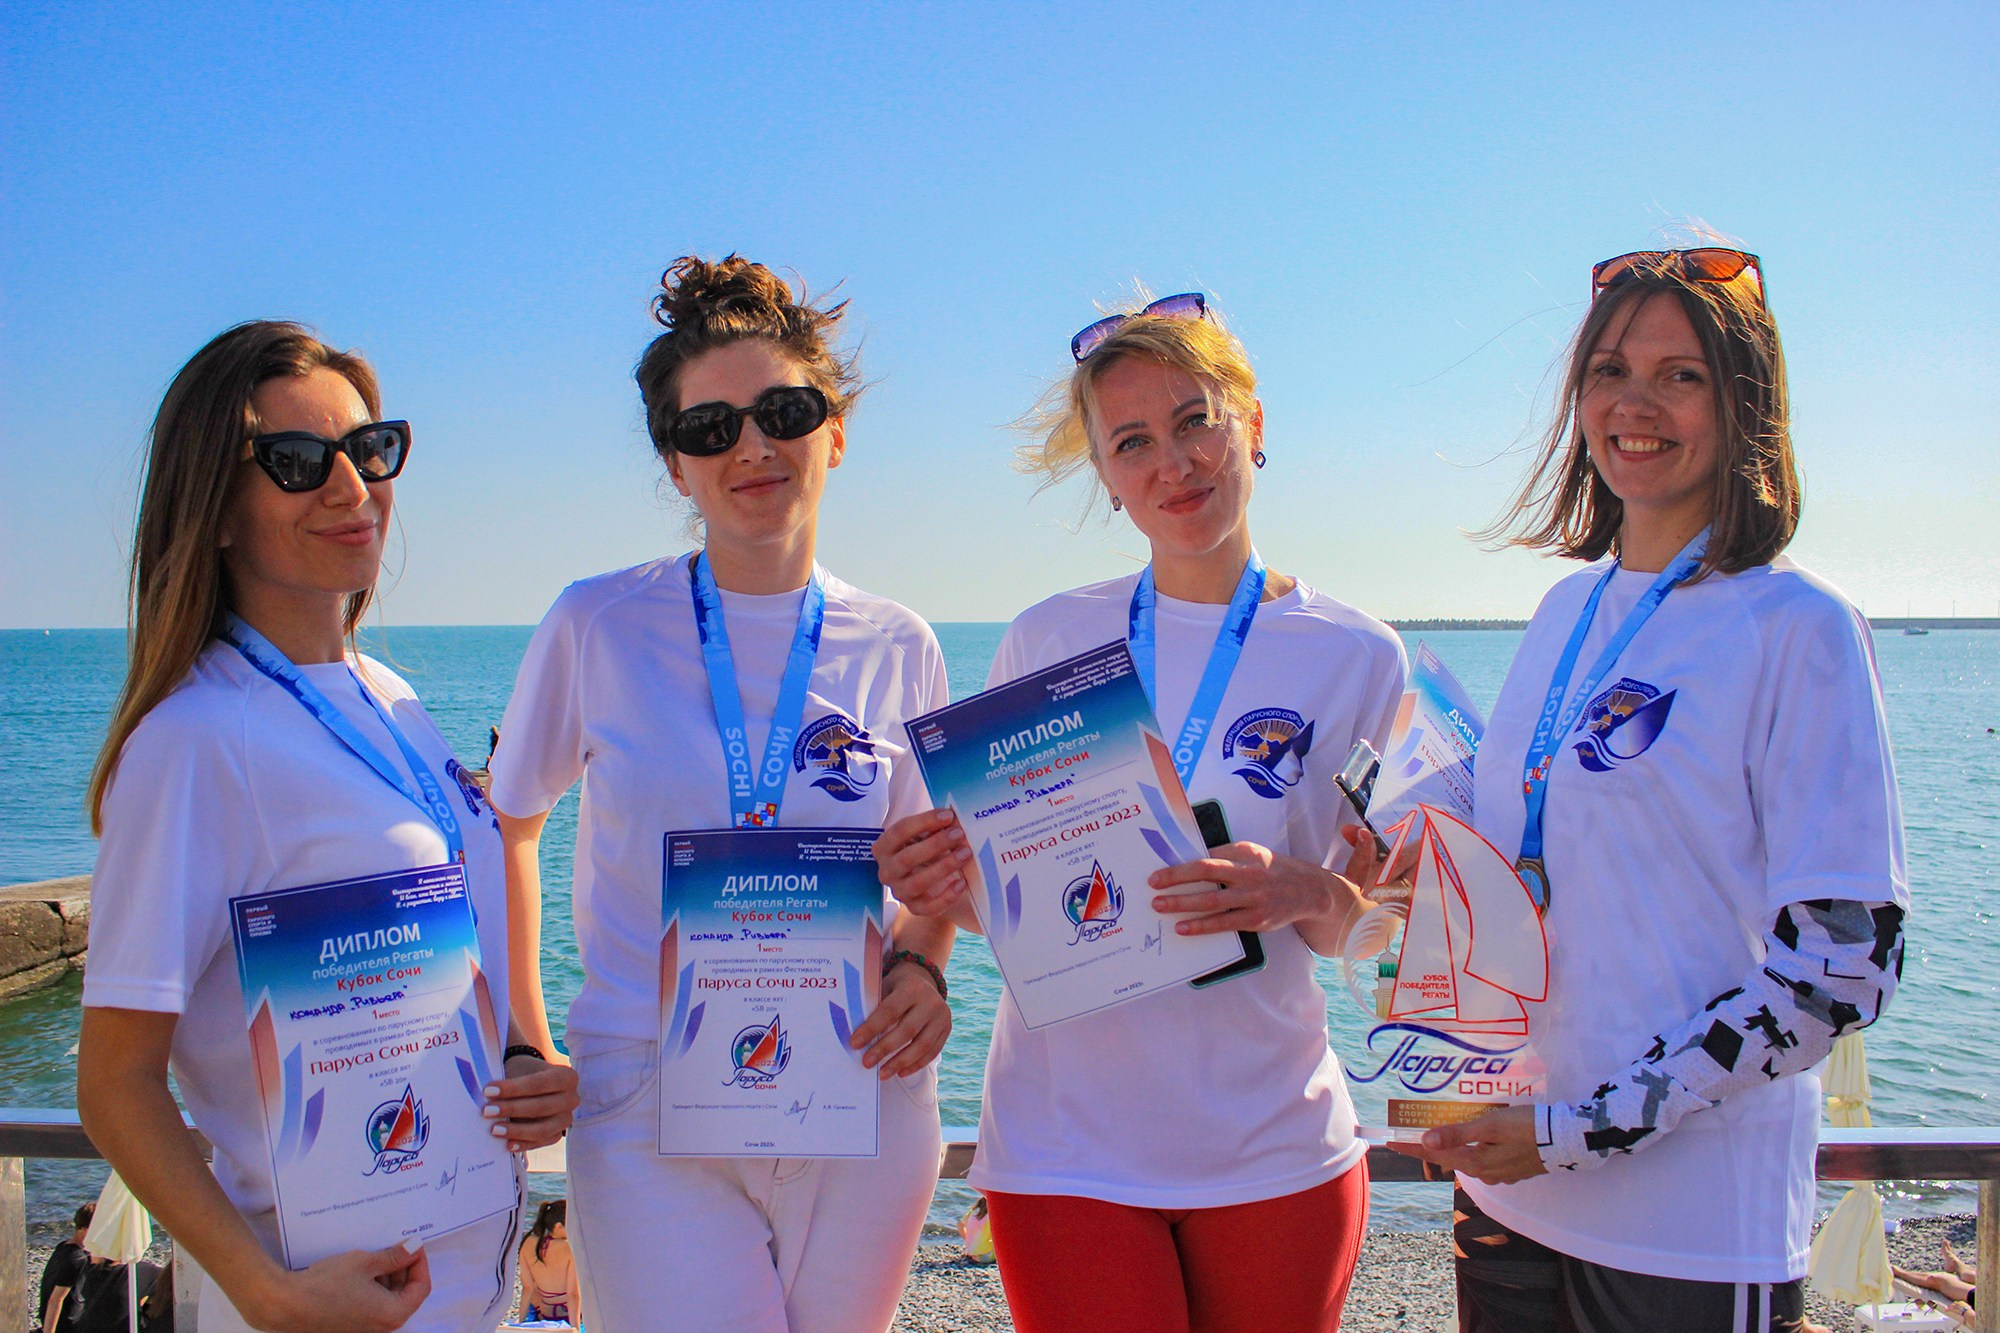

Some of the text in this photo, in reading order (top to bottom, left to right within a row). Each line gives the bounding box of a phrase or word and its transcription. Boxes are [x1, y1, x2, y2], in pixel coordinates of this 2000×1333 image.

[1243, 709, 1282, 724] ПАРУСНОГО
[1531, 685, 1563, 753] SOCHI
[1554, 678, 1595, 741] СОЧИ
[988, 710, 1084, 766] ДИПЛОМ
[725, 727, 751, 798] SOCHI
[763, 726, 793, 788] СОЧИ
[985, 731, 1100, 781] победителя Регаты
[1008, 751, 1090, 787] Кубок Сочи
[1247, 776, 1268, 787] СОЧИ
[418, 772, 457, 834] СОЧИ
[1047, 794, 1075, 808] 1 место
[1003, 814, 1055, 838] соревнованиях
[1055, 810, 1064, 819] по
[1065, 798, 1100, 817] парусному
[1011, 824, 1053, 845] проводимых
[1059, 814, 1083, 829] рамках
[1083, 800, 1120, 818] Фестиваля
[1001, 804, 1141, 864] Паруса Сочи 2023
[1060, 846, 1084, 859] классе
[721, 874, 818, 897] ДИПЛОМ
[713, 896, 828, 910] победителя Регаты
[1093, 904, 1115, 917] 2023
[731, 910, 811, 924] Кубок Сочи
[319, 922, 421, 965] ДИПЛОМ
[1066, 920, 1117, 946] Паруса
[757, 943, 762, 953] 1
[312, 948, 434, 980] победителя Регаты
[711, 967, 753, 975] проводимых
[758, 967, 783, 975] рамках
[783, 966, 821, 974] Фестиваля
[768, 958, 805, 966] парусному
[337, 966, 422, 992] Кубок Сочи
[698, 976, 838, 991] Паруса Сочи 2023
[1399, 982, 1450, 991] ПОБЕДИТЕЛЯ
[1423, 974, 1448, 982] КУБОК
[1422, 991, 1450, 999] РЕГАТЫ
[371, 1009, 401, 1020] 1 место
[319, 1027, 377, 1045] соревнованиях
[388, 1017, 425, 1032] парусному
[325, 1039, 373, 1055] проводимых
[379, 1032, 405, 1045] рамках
[405, 1023, 442, 1037] Фестиваля
[310, 1031, 460, 1075] Паруса Сочи 2023
[1345, 1033, 1514, 1094] Паруса
[374, 1067, 398, 1078] классе
[721, 1070, 775, 1089] Паруса
[1458, 1080, 1533, 1097] СОЧИ
[1398, 1103, 1449, 1111] ФЕСТИВАЛЬ
[1398, 1110, 1433, 1118] СПОРТА
[362, 1151, 419, 1177] Паруса
